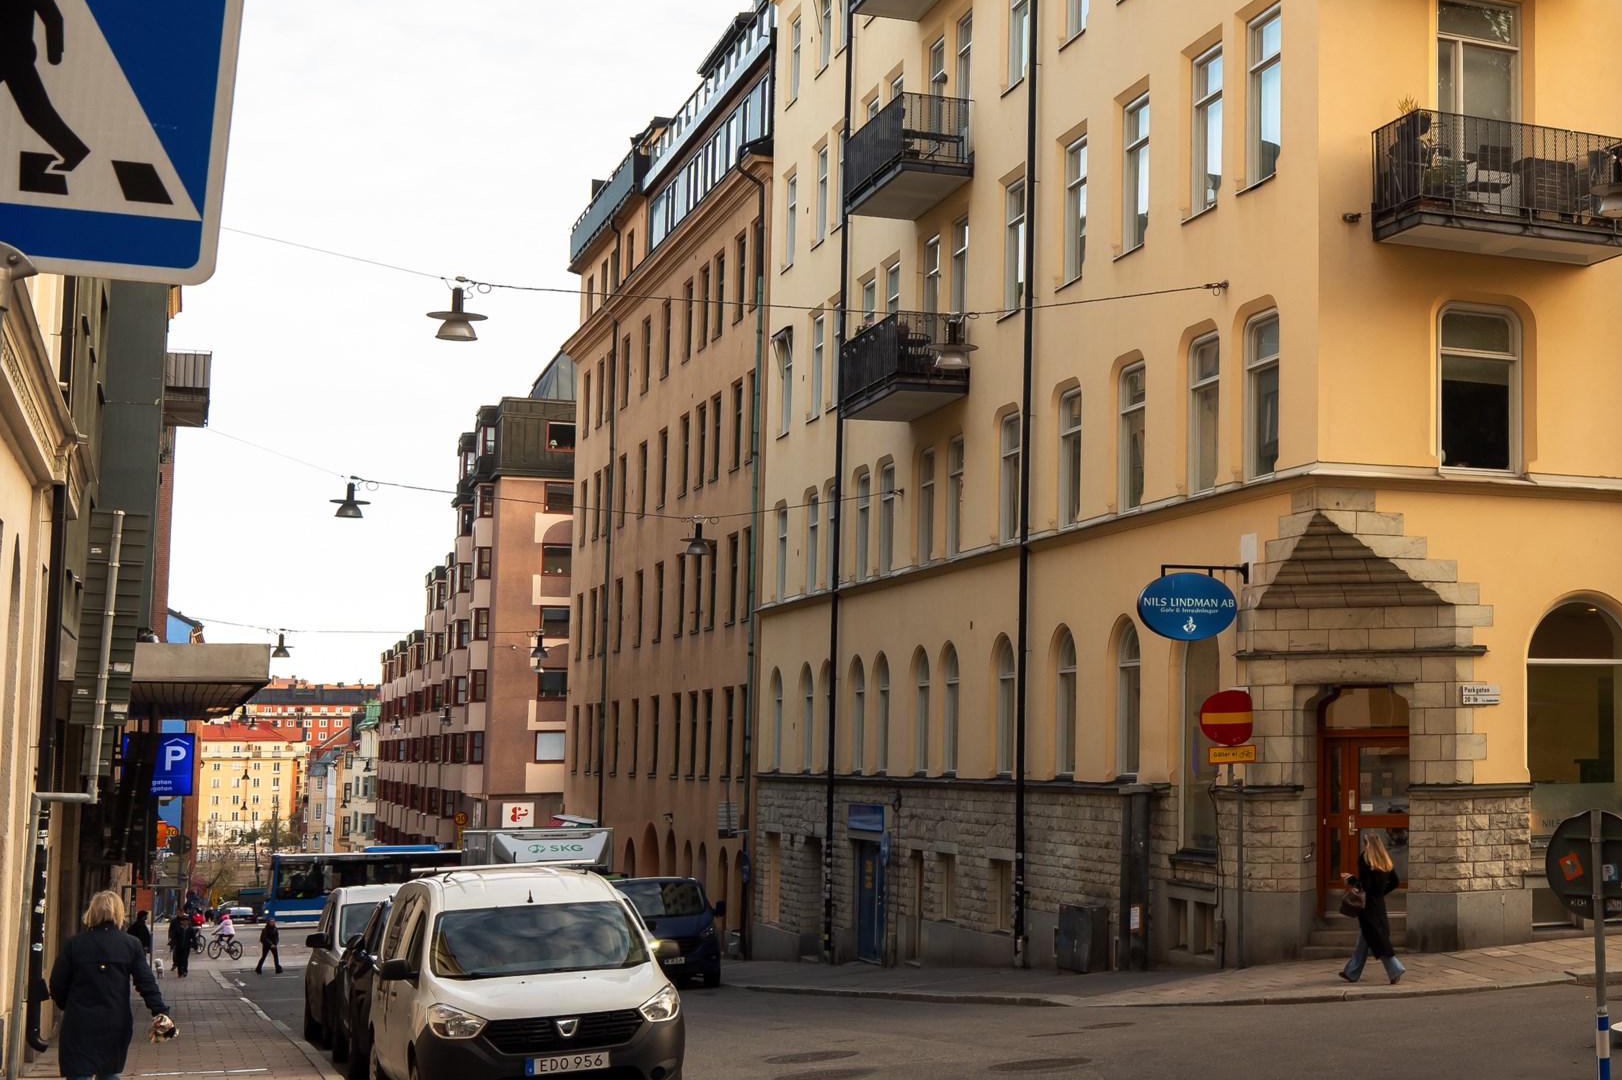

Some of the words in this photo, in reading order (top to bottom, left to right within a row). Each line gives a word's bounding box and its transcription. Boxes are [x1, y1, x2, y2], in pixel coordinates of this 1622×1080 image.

[1143, 597, 1167, 607] NILS
[1170, 598, 1218, 607] LINDMAN
[1220, 599, 1235, 608] AB
[1464, 686, 1490, 695] Parkgatan
[165, 746, 187, 771] P
[550, 844, 584, 852] SKG
[574, 1054, 603, 1069] 956
